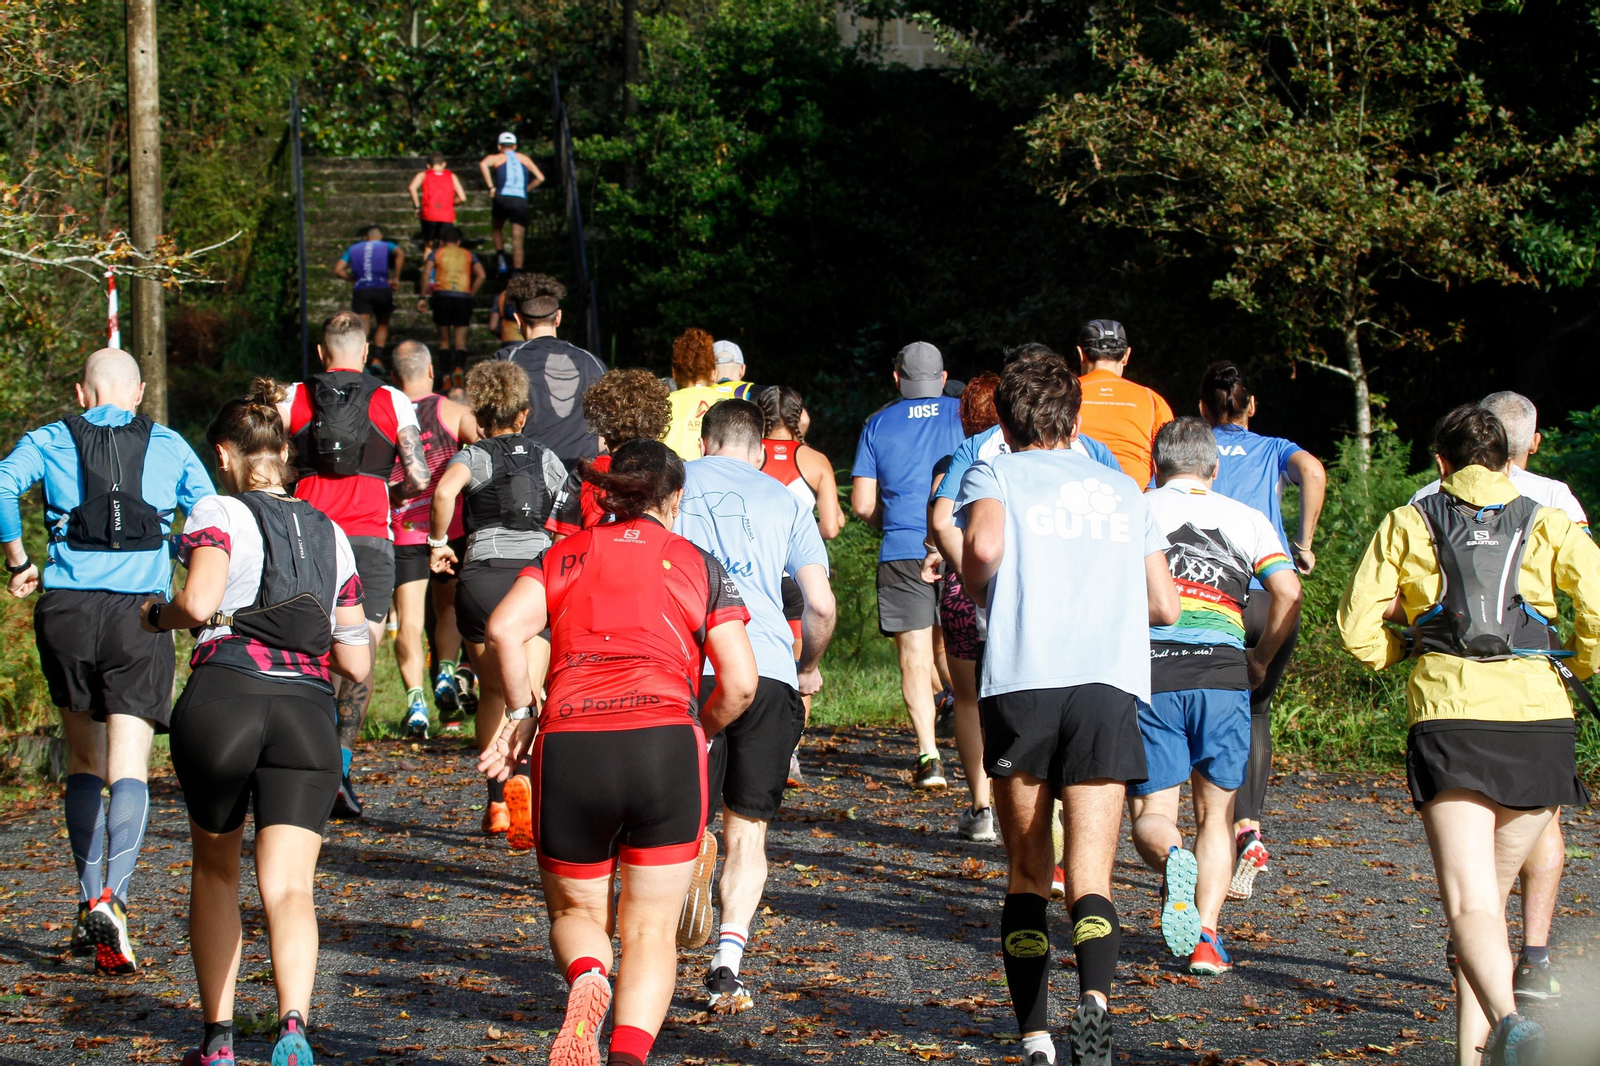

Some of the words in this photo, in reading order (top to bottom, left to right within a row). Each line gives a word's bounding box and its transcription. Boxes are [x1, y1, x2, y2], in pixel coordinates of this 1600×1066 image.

[907, 403, 939, 419] JOSE
[1216, 445, 1247, 456] VA
[113, 500, 121, 531] EVADICT
[1026, 504, 1130, 543] GUTE
[613, 537, 646, 545] salomon
